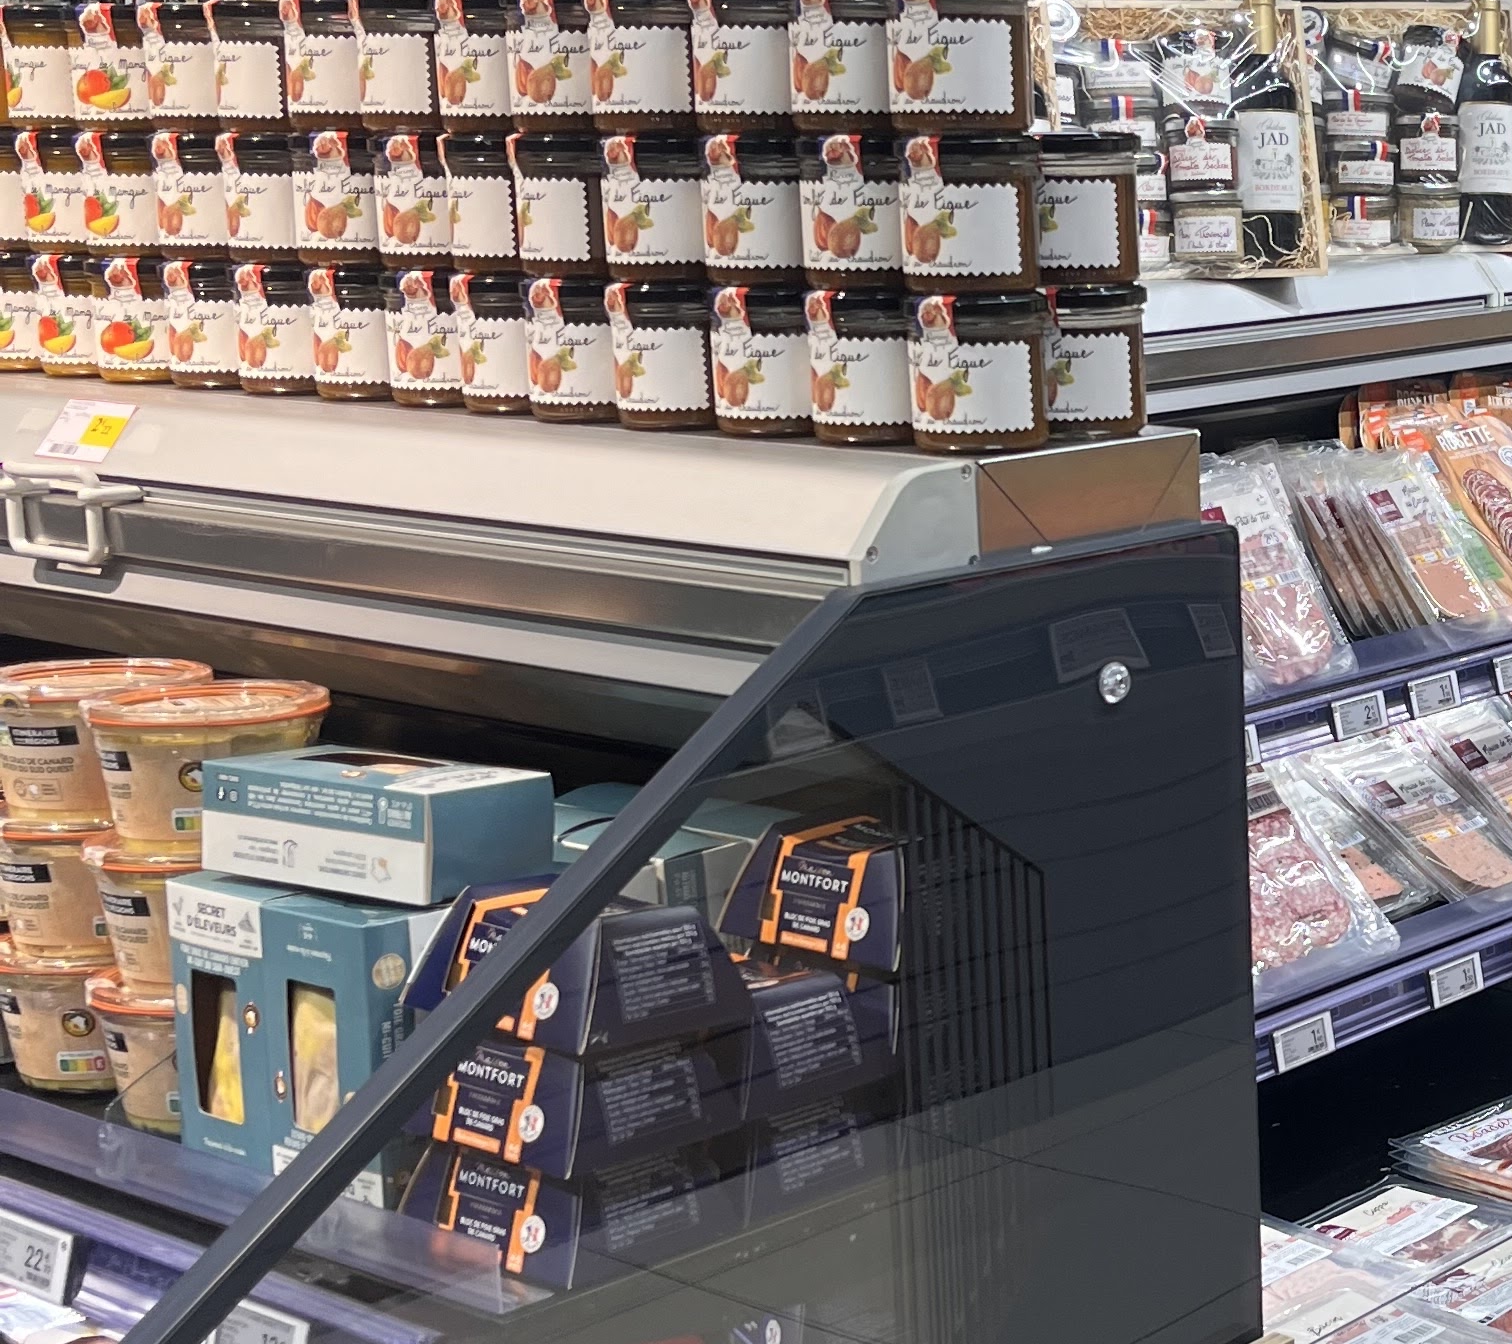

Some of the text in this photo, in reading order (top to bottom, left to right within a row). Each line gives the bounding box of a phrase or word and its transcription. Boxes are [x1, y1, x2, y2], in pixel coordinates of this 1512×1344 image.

[460, 38, 499, 71] Figue
[549, 38, 590, 68] Figue
[607, 28, 647, 66] Figue
[710, 28, 751, 65] Figue
[823, 26, 868, 63] Figue
[906, 22, 974, 61] de Figue
[1258, 132, 1290, 149] JAD
[1477, 122, 1507, 138] JAD
[108, 185, 149, 210] Mangue
[176, 176, 213, 203] Figue
[234, 177, 268, 205] Figue
[340, 177, 376, 207] Figue
[413, 179, 448, 211] Figue
[630, 183, 673, 217] Figue
[731, 183, 775, 220] Figue
[829, 188, 899, 221] de Figue
[914, 187, 980, 225] de Figue
[187, 301, 223, 331] Figue
[259, 306, 298, 338] Figue
[332, 313, 370, 342] Figue
[468, 323, 504, 352] Figue
[555, 328, 598, 360] Figue
[626, 336, 664, 366] Figue
[742, 340, 786, 373] Figue
[828, 343, 871, 376] Figue
[927, 348, 994, 386] de Figue
[1050, 340, 1095, 375] Figue
[1435, 424, 1496, 453] ROSETTE
[781, 869, 849, 894] MONTFORT
[197, 902, 227, 920] SECRET
[457, 1060, 526, 1089] MONTFORT
[458, 1167, 525, 1198] MONTFORT
